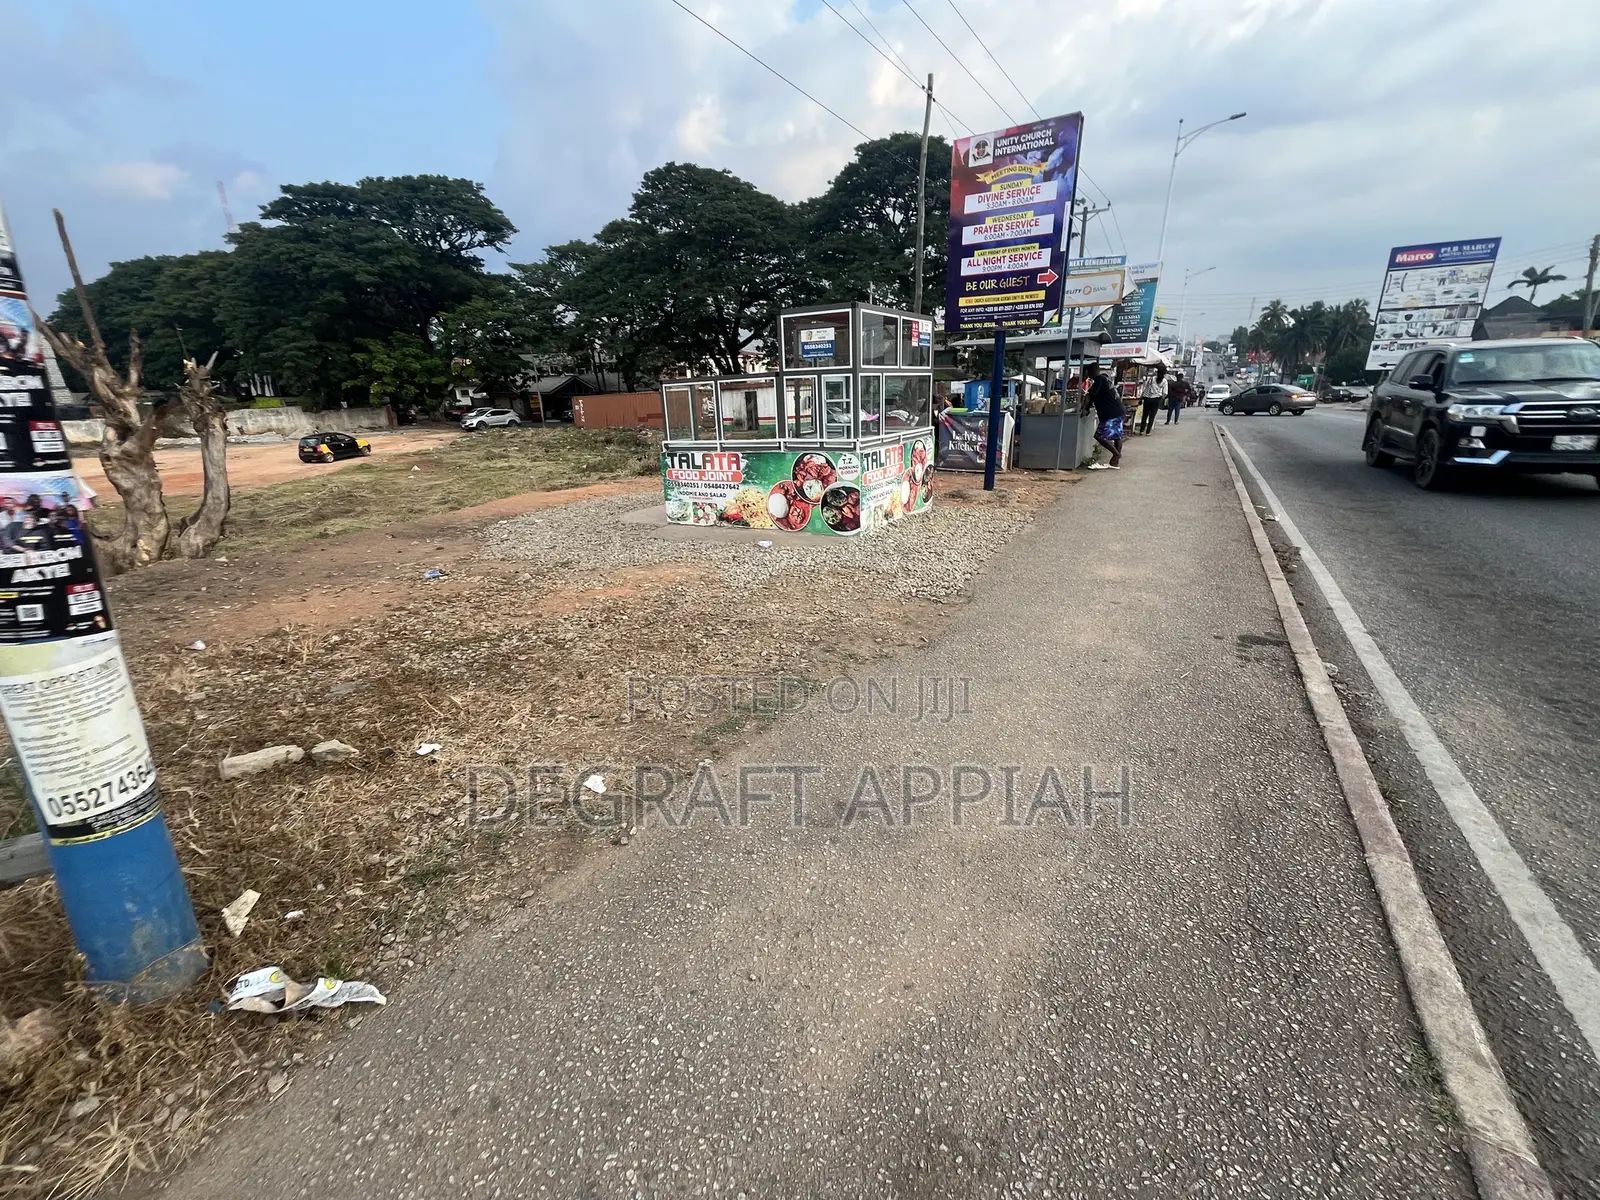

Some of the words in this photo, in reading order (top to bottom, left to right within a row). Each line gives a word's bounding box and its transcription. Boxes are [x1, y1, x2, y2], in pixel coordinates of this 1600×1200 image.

[997, 136, 1019, 147] UNITY
[1020, 129, 1052, 142] CHURCH
[995, 137, 1054, 156] INTERNATIONAL
[992, 166, 1017, 180] MEETING
[1000, 181, 1023, 190] SUNDAY
[978, 191, 1004, 204] DIVINE
[1006, 185, 1041, 199] SERVICE
[992, 213, 1028, 223] WEDNESDAY
[973, 223, 1003, 235] PRAYER
[1005, 218, 1040, 231] SERVICE
[984, 231, 1006, 240] 6:00AM
[1010, 228, 1032, 237] 7:00AM
[1463, 242, 1495, 252] MARCO
[967, 259, 981, 268] ALL
[983, 256, 1006, 266] NIGHT
[1008, 251, 1043, 263] SERVICE
[1070, 259, 1083, 267] NEXT
[1085, 257, 1121, 266] GENERATION
[1395, 252, 1434, 263] Marco
[982, 264, 1002, 272] 9:00PM
[1007, 262, 1028, 270] 4:00AM
[965, 281, 978, 292] BE
[979, 279, 998, 290] OUR
[1000, 276, 1030, 288] GUEST
[949, 441, 977, 452] Kitchen
[667, 452, 741, 471] TALATA
[864, 445, 903, 471] TALATA
[672, 470, 700, 480] FOOD
[702, 471, 733, 481] JOINT
[866, 470, 884, 483] FOOD
